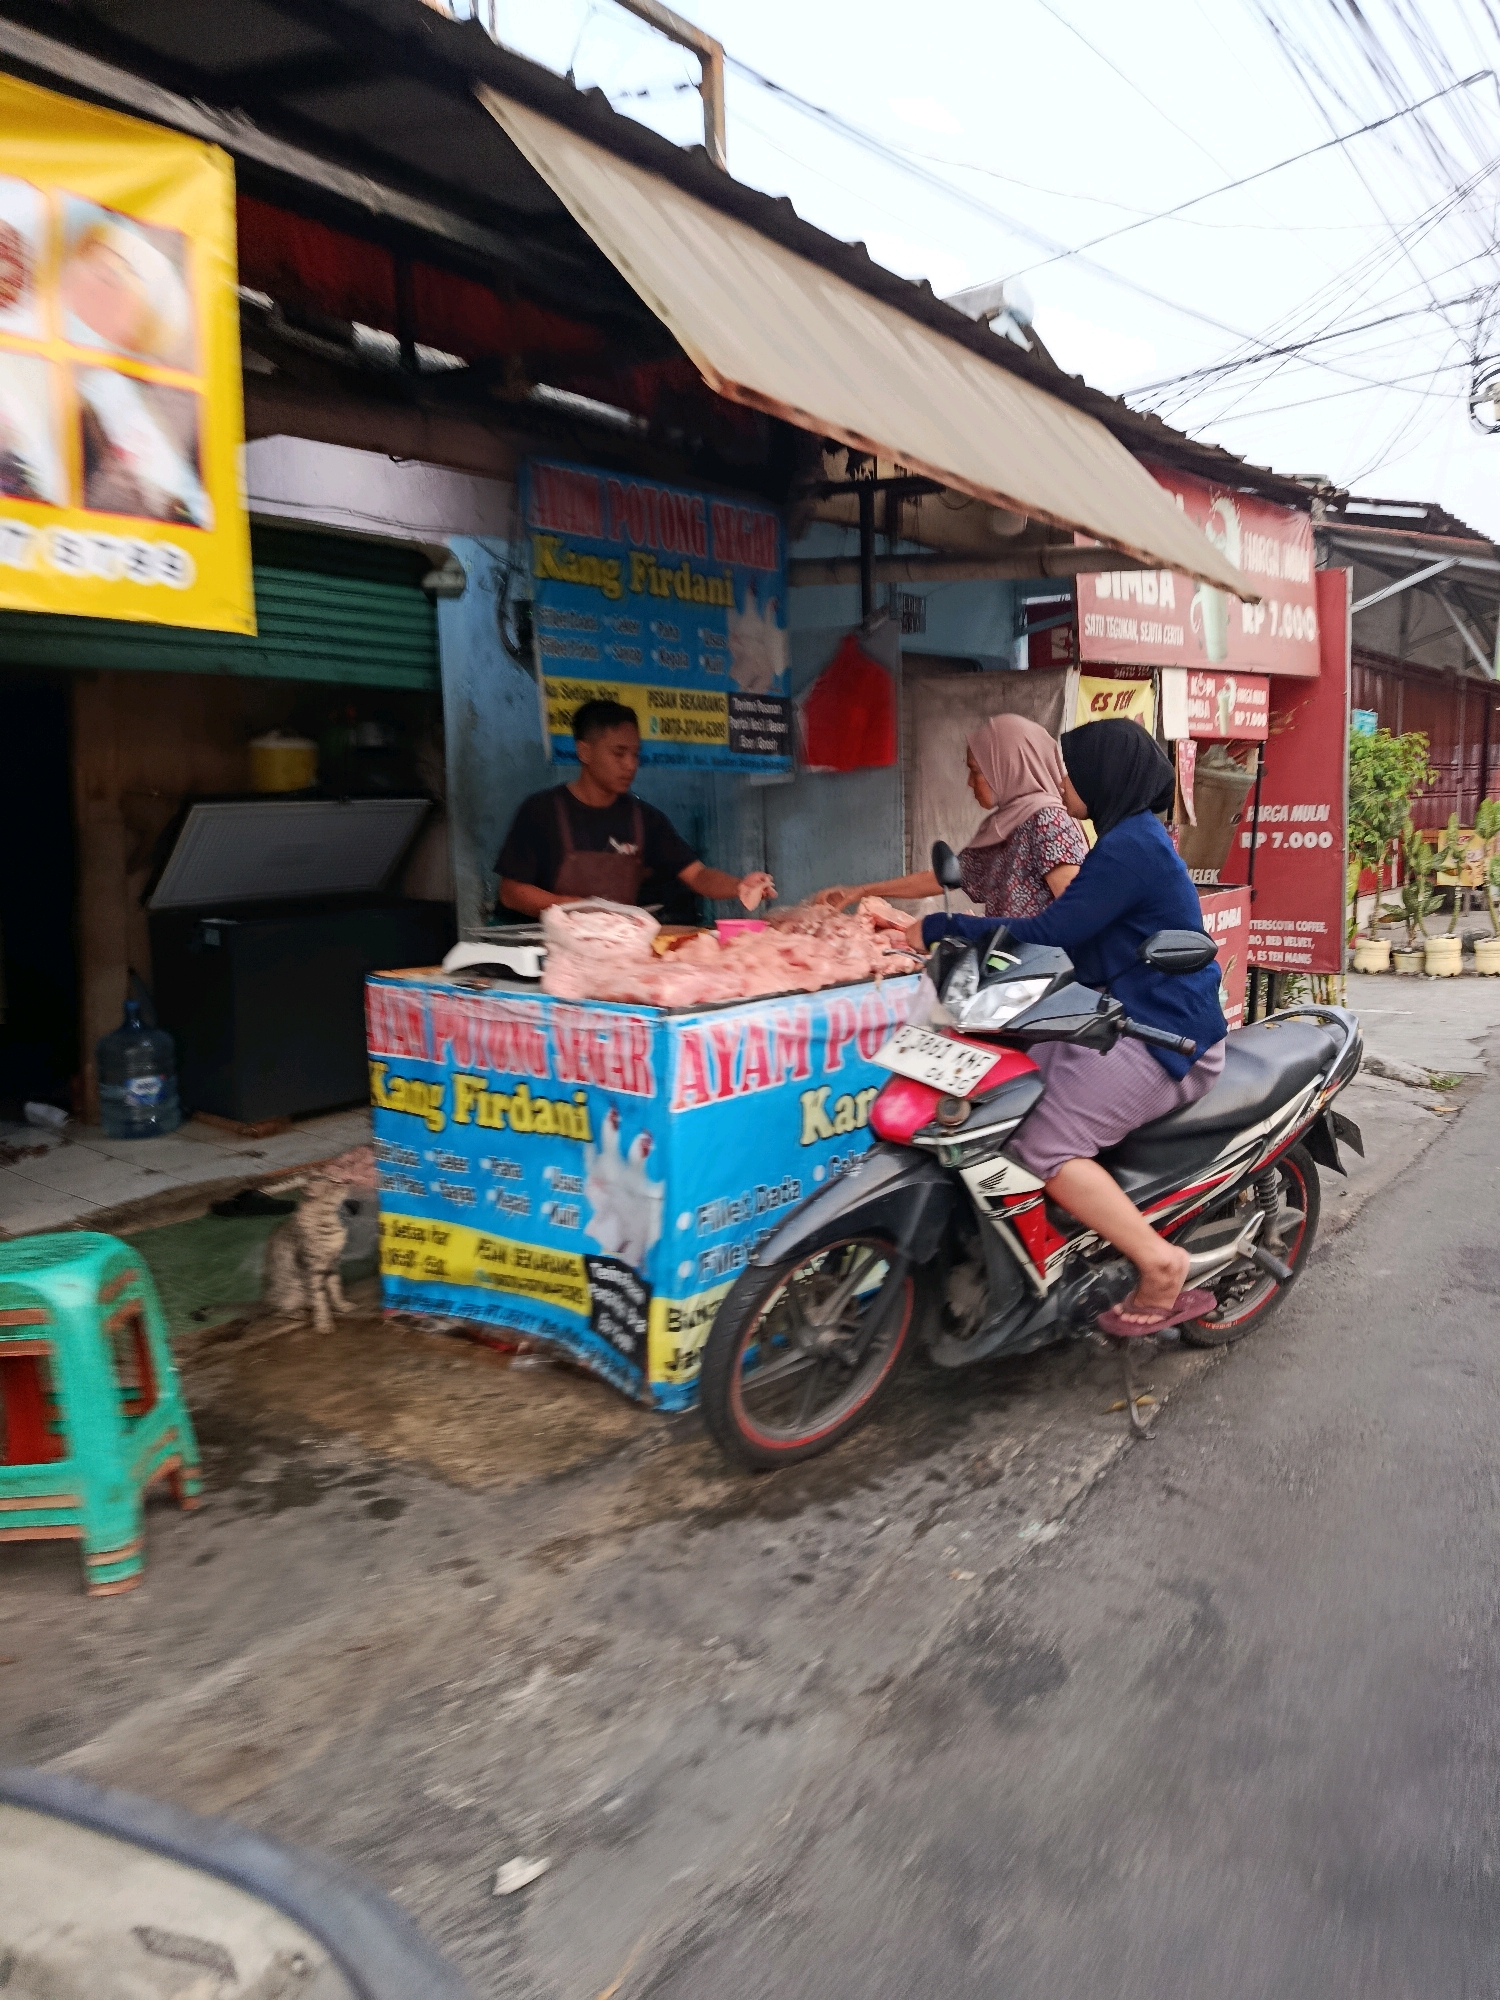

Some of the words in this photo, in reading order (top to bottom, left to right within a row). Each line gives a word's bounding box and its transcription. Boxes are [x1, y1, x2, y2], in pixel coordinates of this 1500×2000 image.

[606, 478, 707, 558] POTONG
[532, 533, 623, 600] Kang
[627, 550, 736, 608] Firdani
[1084, 612, 1105, 638] SATU
[1140, 620, 1163, 644] SEJUTA
[1268, 599, 1317, 643] 7.000
[1090, 692, 1113, 712] ES
[1290, 804, 1331, 822] MULAI
[1241, 830, 1268, 849] RP
[1271, 830, 1334, 849] 7.000
[1217, 906, 1242, 932] SIMBA
[1296, 920, 1329, 934] COFFEE,
[1265, 935, 1283, 947] RED
[428, 992, 550, 1080] POTONG
[670, 1006, 812, 1113] AYAM
[369, 1060, 446, 1133] Kang
[451, 1072, 594, 1143] Firdani
[695, 1189, 754, 1238] Fillet
[753, 1174, 803, 1216] Dada
